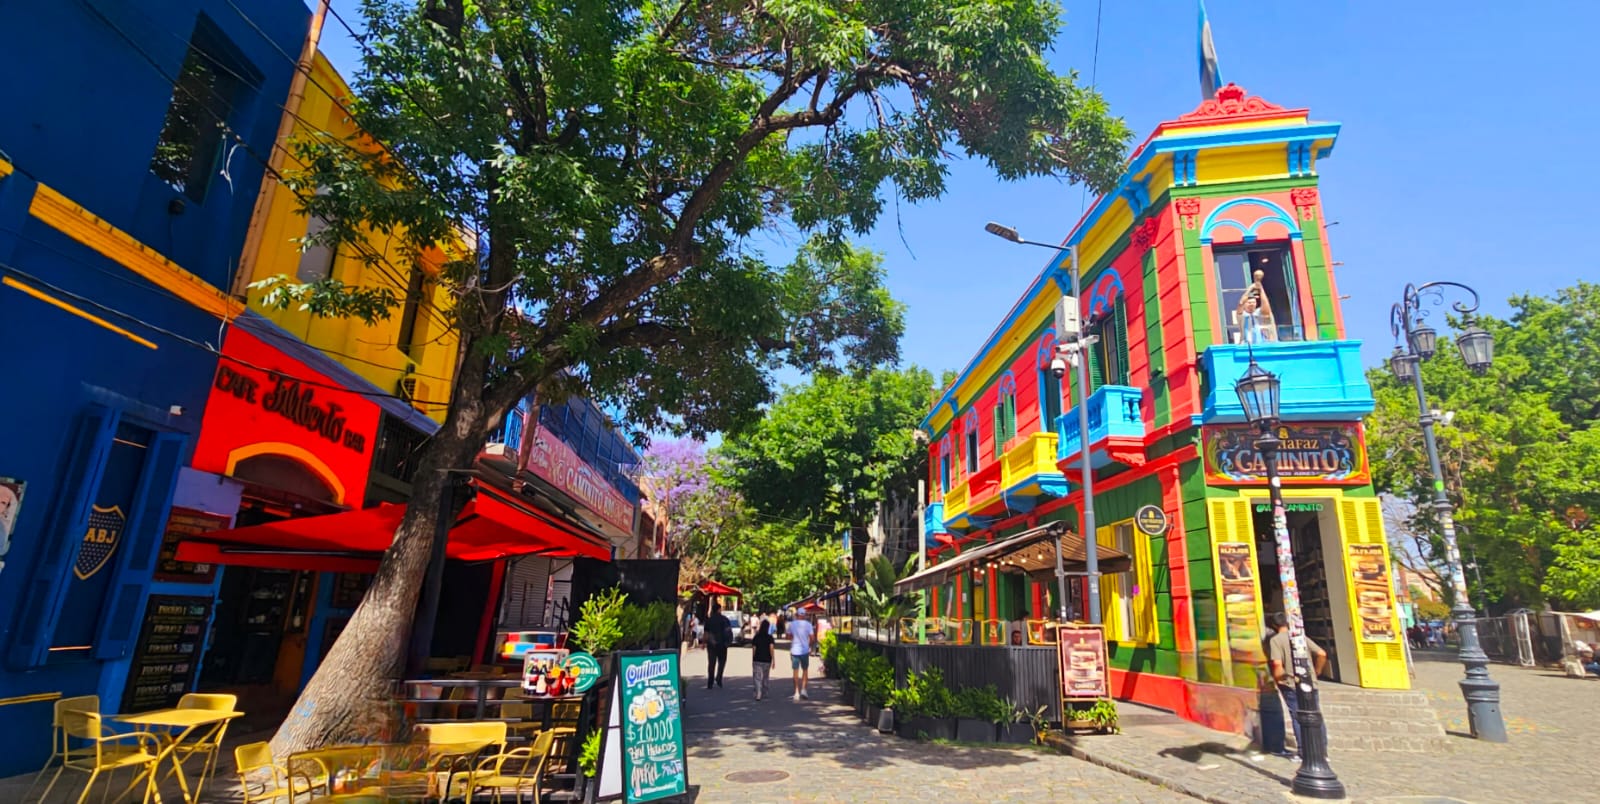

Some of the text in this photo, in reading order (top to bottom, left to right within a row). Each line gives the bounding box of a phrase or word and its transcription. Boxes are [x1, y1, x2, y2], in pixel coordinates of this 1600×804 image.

[216, 366, 259, 404] CAFE
[344, 429, 365, 454] BAR
[566, 467, 603, 511] CAMINITO
[625, 659, 669, 688] Quilmes
